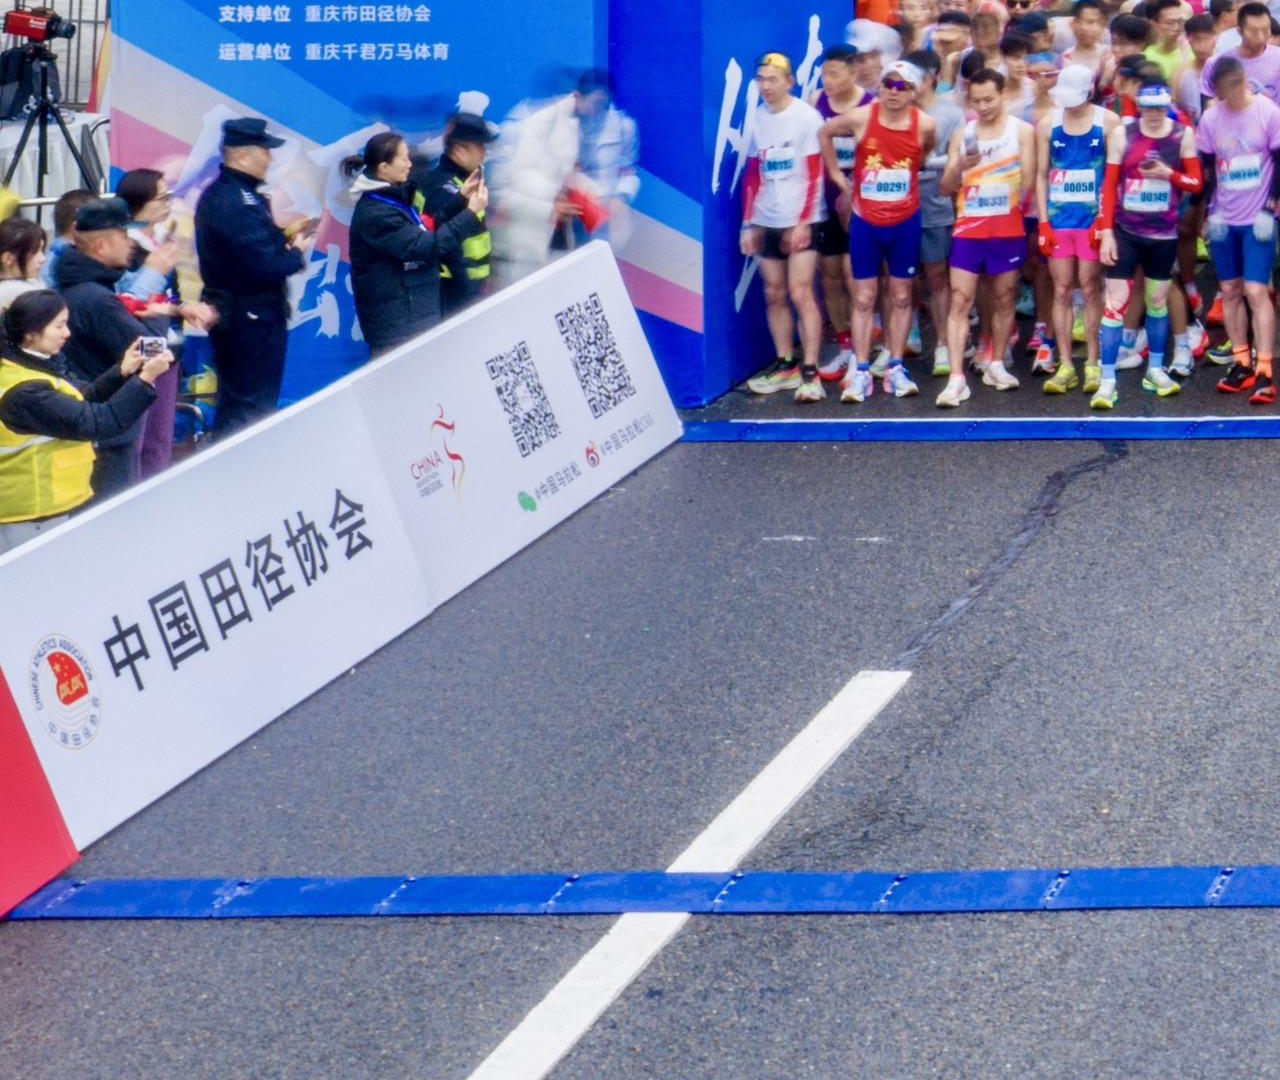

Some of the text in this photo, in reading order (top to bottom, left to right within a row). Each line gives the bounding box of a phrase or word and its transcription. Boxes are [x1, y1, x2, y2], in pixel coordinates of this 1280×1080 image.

[220, 5, 430, 22] 支持单位 重庆市田径协会
[219, 43, 448, 61] 运营单位 重庆千君万马体育
[877, 181, 907, 193] 00291
[1064, 182, 1094, 193] 00058
[410, 451, 444, 480] CHINA
[103, 488, 373, 693] 中国田径协会
[32, 671, 44, 711] CHINESE
